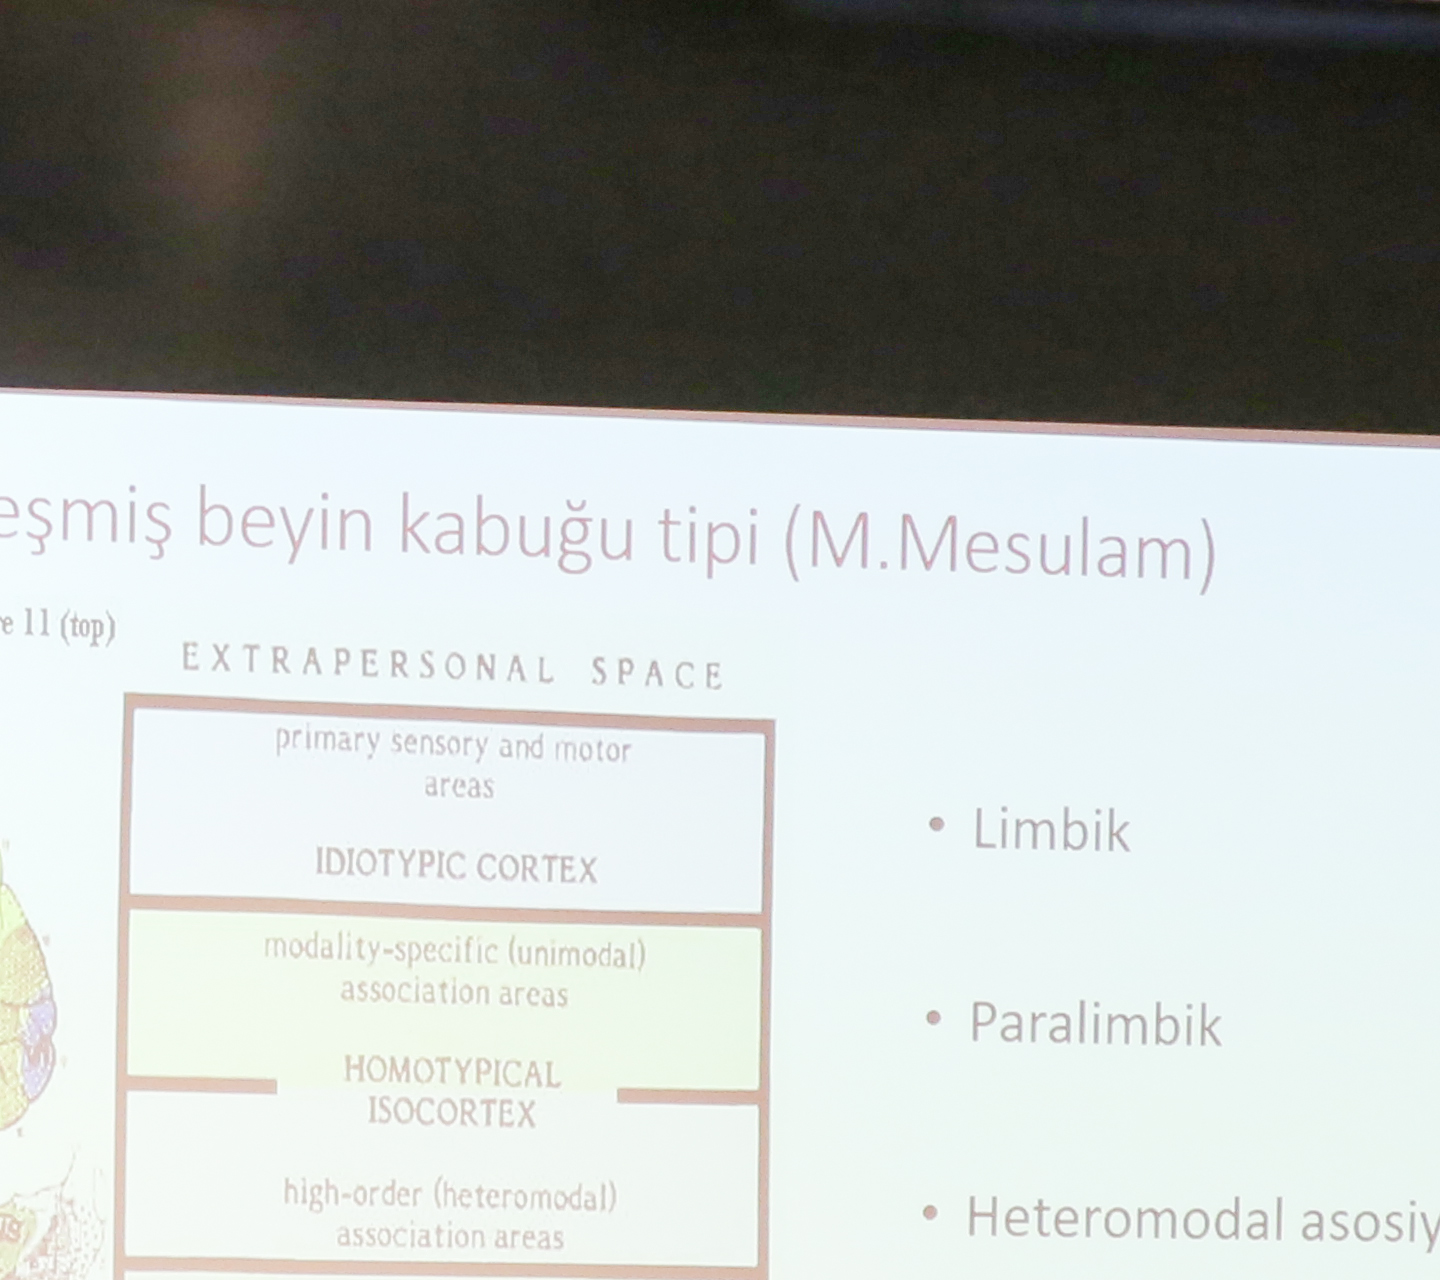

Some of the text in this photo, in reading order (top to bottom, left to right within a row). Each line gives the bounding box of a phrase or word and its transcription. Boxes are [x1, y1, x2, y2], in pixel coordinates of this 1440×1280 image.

[199, 484, 373, 564] beyin
[401, 491, 634, 575] kabuğu
[659, 505, 759, 579] tipi
[786, 503, 1216, 596] (M.Mesulam)
[61, 609, 118, 648] (top)
[183, 641, 724, 691] EXTRAPERSONAL SPACE
[276, 726, 632, 764] primary sensory and motor
[424, 772, 496, 801] areas
[974, 806, 1131, 852] Limbik
[316, 846, 599, 886] IDIOTYPIC CORTEX
[264, 931, 647, 971] modality-specific (unimodal)
[341, 976, 569, 1009] association areas
[971, 1000, 1223, 1047] Paralimbik
[343, 1054, 563, 1090] HOMOTYPICAL
[368, 1096, 538, 1130] ISOCORTEX
[284, 1177, 619, 1215] high-order (heteromodal)
[337, 1220, 565, 1252] association areas
[968, 1195, 1284, 1242] Heteromodal
